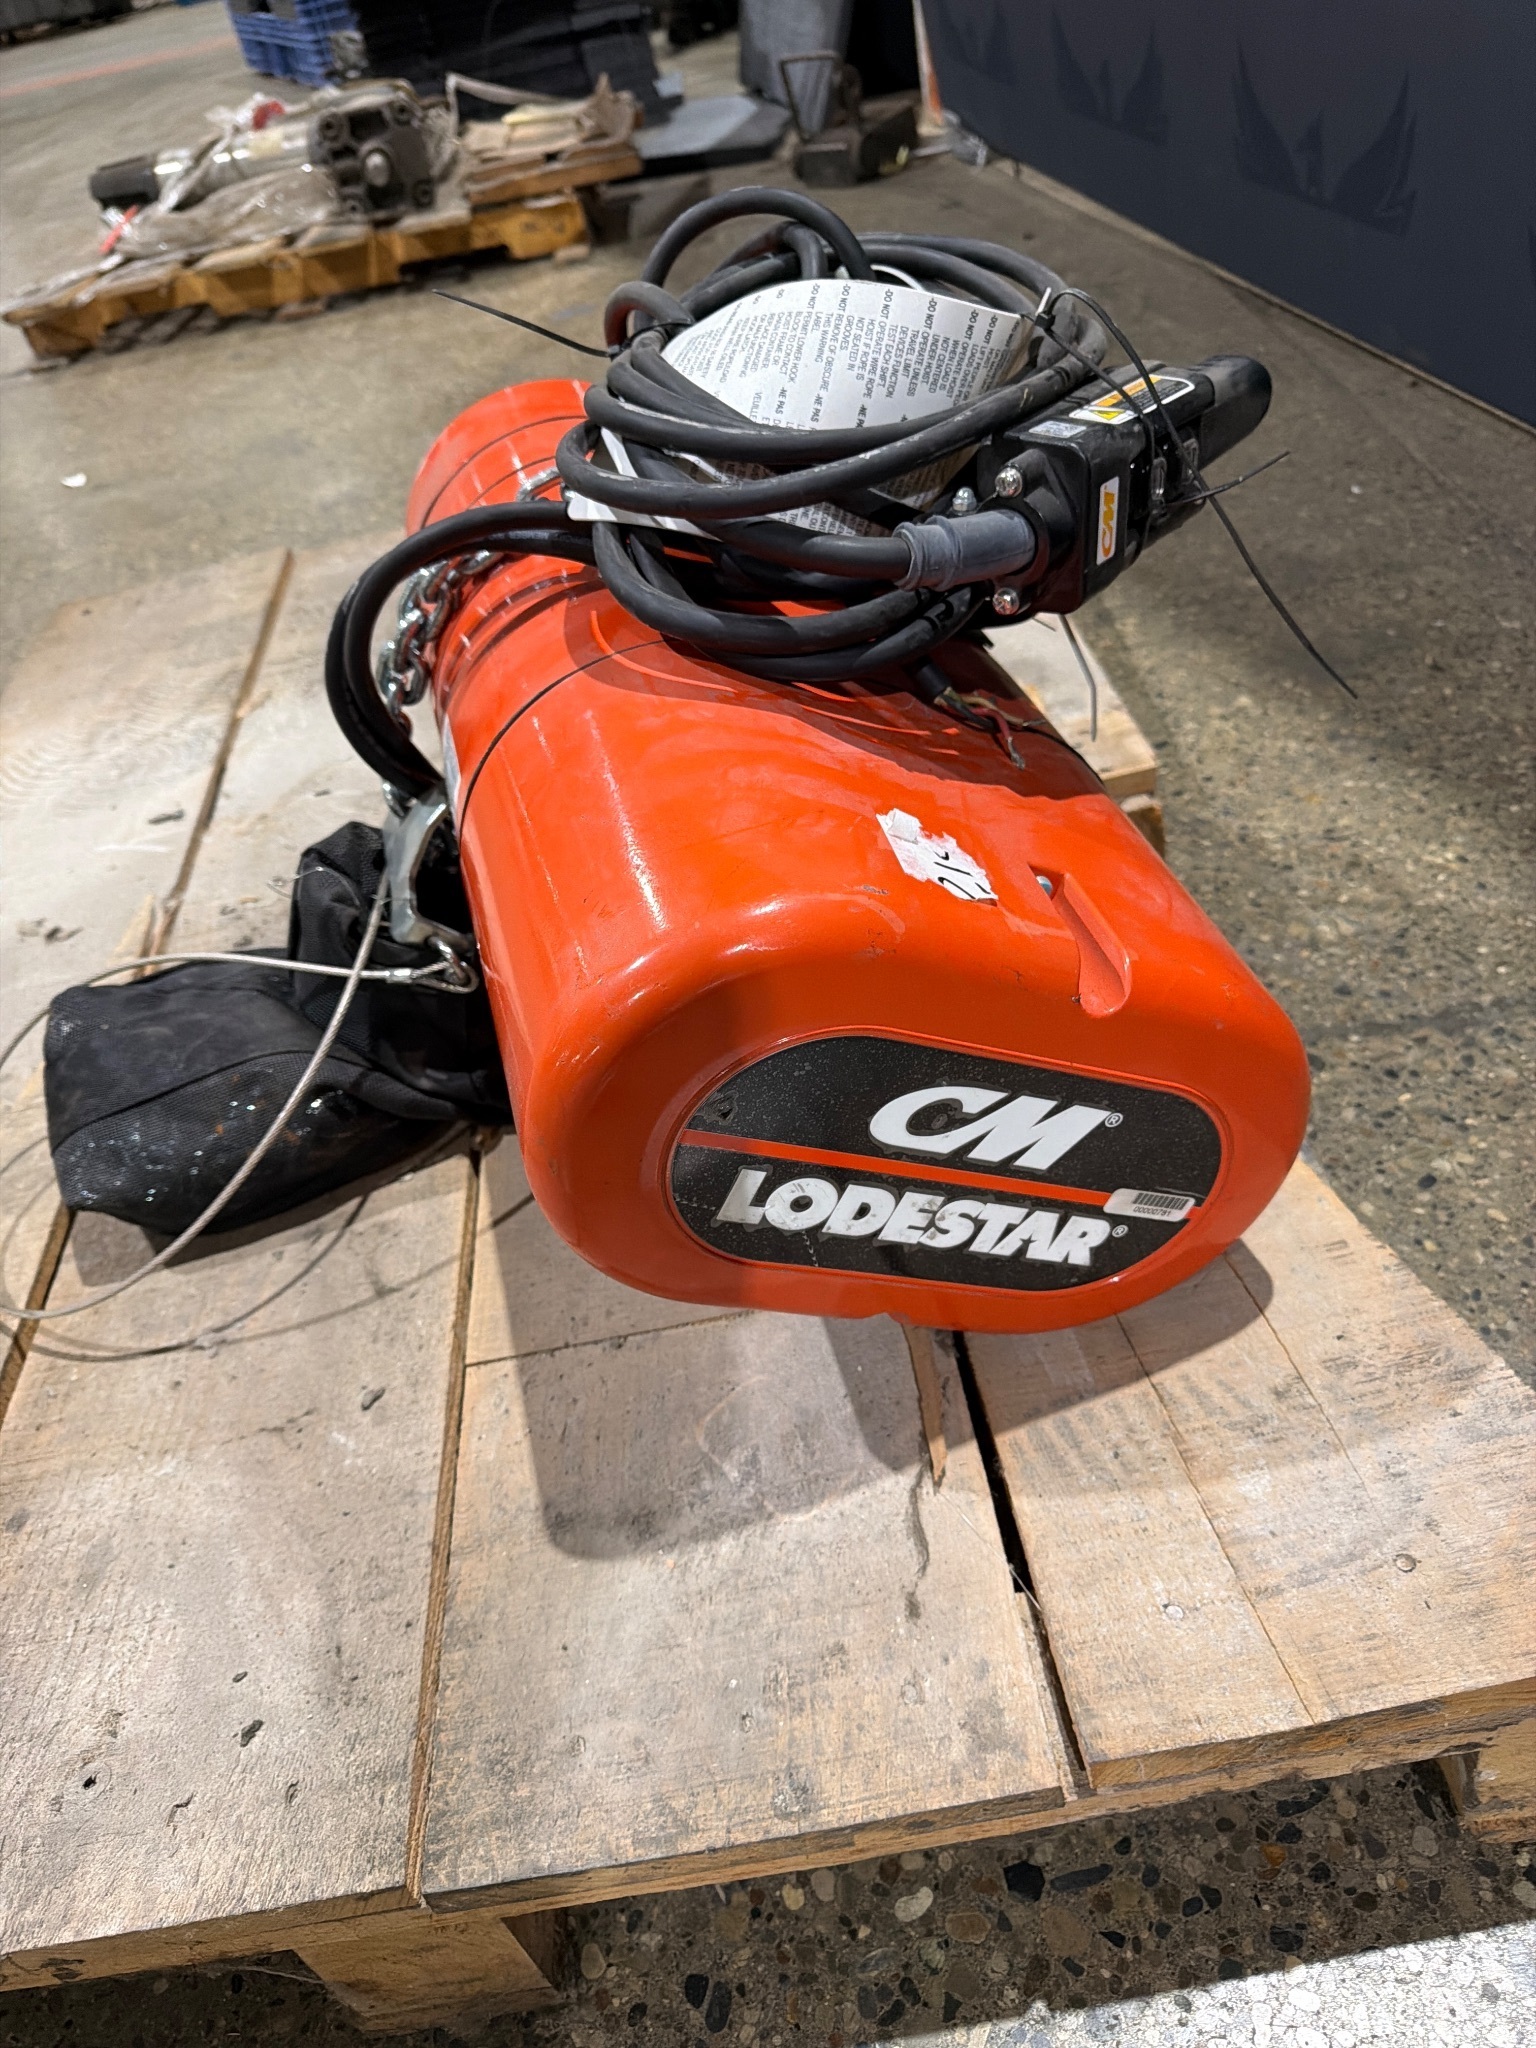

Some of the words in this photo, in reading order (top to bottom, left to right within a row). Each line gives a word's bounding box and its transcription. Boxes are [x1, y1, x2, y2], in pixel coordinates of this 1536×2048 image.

[806, 296, 817, 310] NOT
[838, 298, 848, 313] NOT
[884, 289, 893, 302] -DO
[928, 298, 937, 312] -DO
[790, 311, 804, 333] BLOCK
[822, 312, 834, 328] THIS
[880, 304, 890, 320] NOT
[924, 313, 934, 330] NOT
[969, 309, 979, 323] -DO
[989, 315, 998, 328] -DO
[799, 311, 813, 336] PERMIT
[829, 314, 844, 344] REMOVE
[855, 317, 866, 332] NOT
[864, 319, 876, 341] HOIST
[888, 324, 899, 344] TEST
[964, 324, 974, 341] NOT
[774, 332, 788, 355] FRAME
[787, 334, 798, 343] TO
[814, 330, 829, 363] WARNING
[862, 342, 871, 350] IF
[872, 321, 887, 356] OPERATE
[894, 326, 909, 359] DEVICES
[906, 330, 919, 356] TRAVEL
[940, 337, 950, 353] NOT
[983, 329, 993, 344] NOT
[750, 342, 766, 373] DAMAGED
[793, 337, 806, 361] LOWER
[849, 333, 862, 362] SEATED
[882, 344, 894, 365] EACH
[914, 331, 930, 366] OPERATE
[927, 335, 941, 361] UNDER
[948, 340, 960, 362] WHEN
[966, 344, 979, 368] LOADS
[977, 346, 987, 361] LIFT
[772, 356, 782, 366] OR
[779, 344, 794, 375] CONTACT
[847, 363, 856, 371] IN
[857, 351, 870, 372] ROPE
[868, 357, 879, 376] WIRE
[901, 358, 913, 378] LIMIT
[953, 342, 969, 376] OPERATE
[787, 363, 799, 383] HOOK
[819, 356, 835, 392] OBSCURE
[856, 373, 865, 381] IS
[885, 360, 902, 398] FUNCTION
[907, 367, 921, 397] UNLESS
[928, 354, 946, 394] CENTERED
[941, 363, 953, 383] LOAD
[967, 362, 981, 388] PEOPLE
[863, 377, 876, 399] ROPE
[939, 383, 947, 391] IS
[946, 377, 957, 398] HOIST
[749, 392, 763, 421] VEUILLE
[775, 401, 785, 415] PAS
[810, 408, 821, 423] PAS
